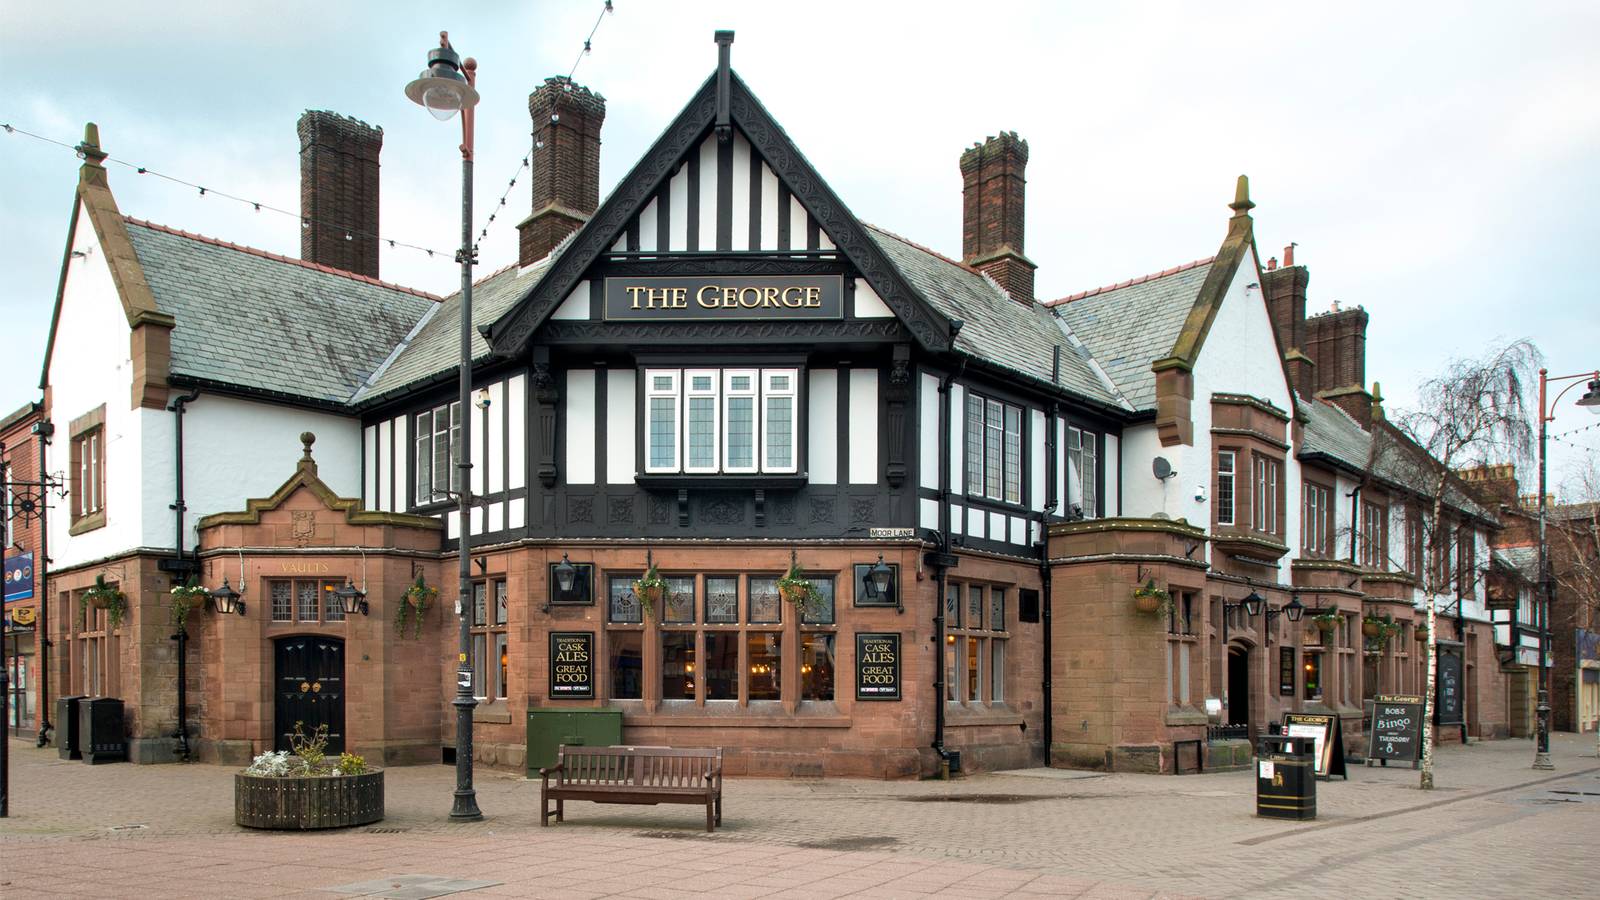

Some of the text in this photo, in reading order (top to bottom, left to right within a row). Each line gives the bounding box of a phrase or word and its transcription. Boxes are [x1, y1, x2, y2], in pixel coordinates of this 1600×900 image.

[626, 285, 821, 309] THE GEORGE
[871, 529, 913, 537] MOOR LANE
[280, 560, 329, 573] VAULTS
[558, 643, 585, 651] CASK
[865, 644, 891, 652] CASK
[556, 651, 588, 662] ALES
[862, 652, 895, 663] ALES
[556, 665, 588, 673] GREAT
[862, 666, 895, 675] GREAT
[556, 673, 588, 683] FOOD
[863, 674, 894, 684] FOOD
[1394, 695, 1419, 703] George
[1377, 718, 1410, 730] Bingo
